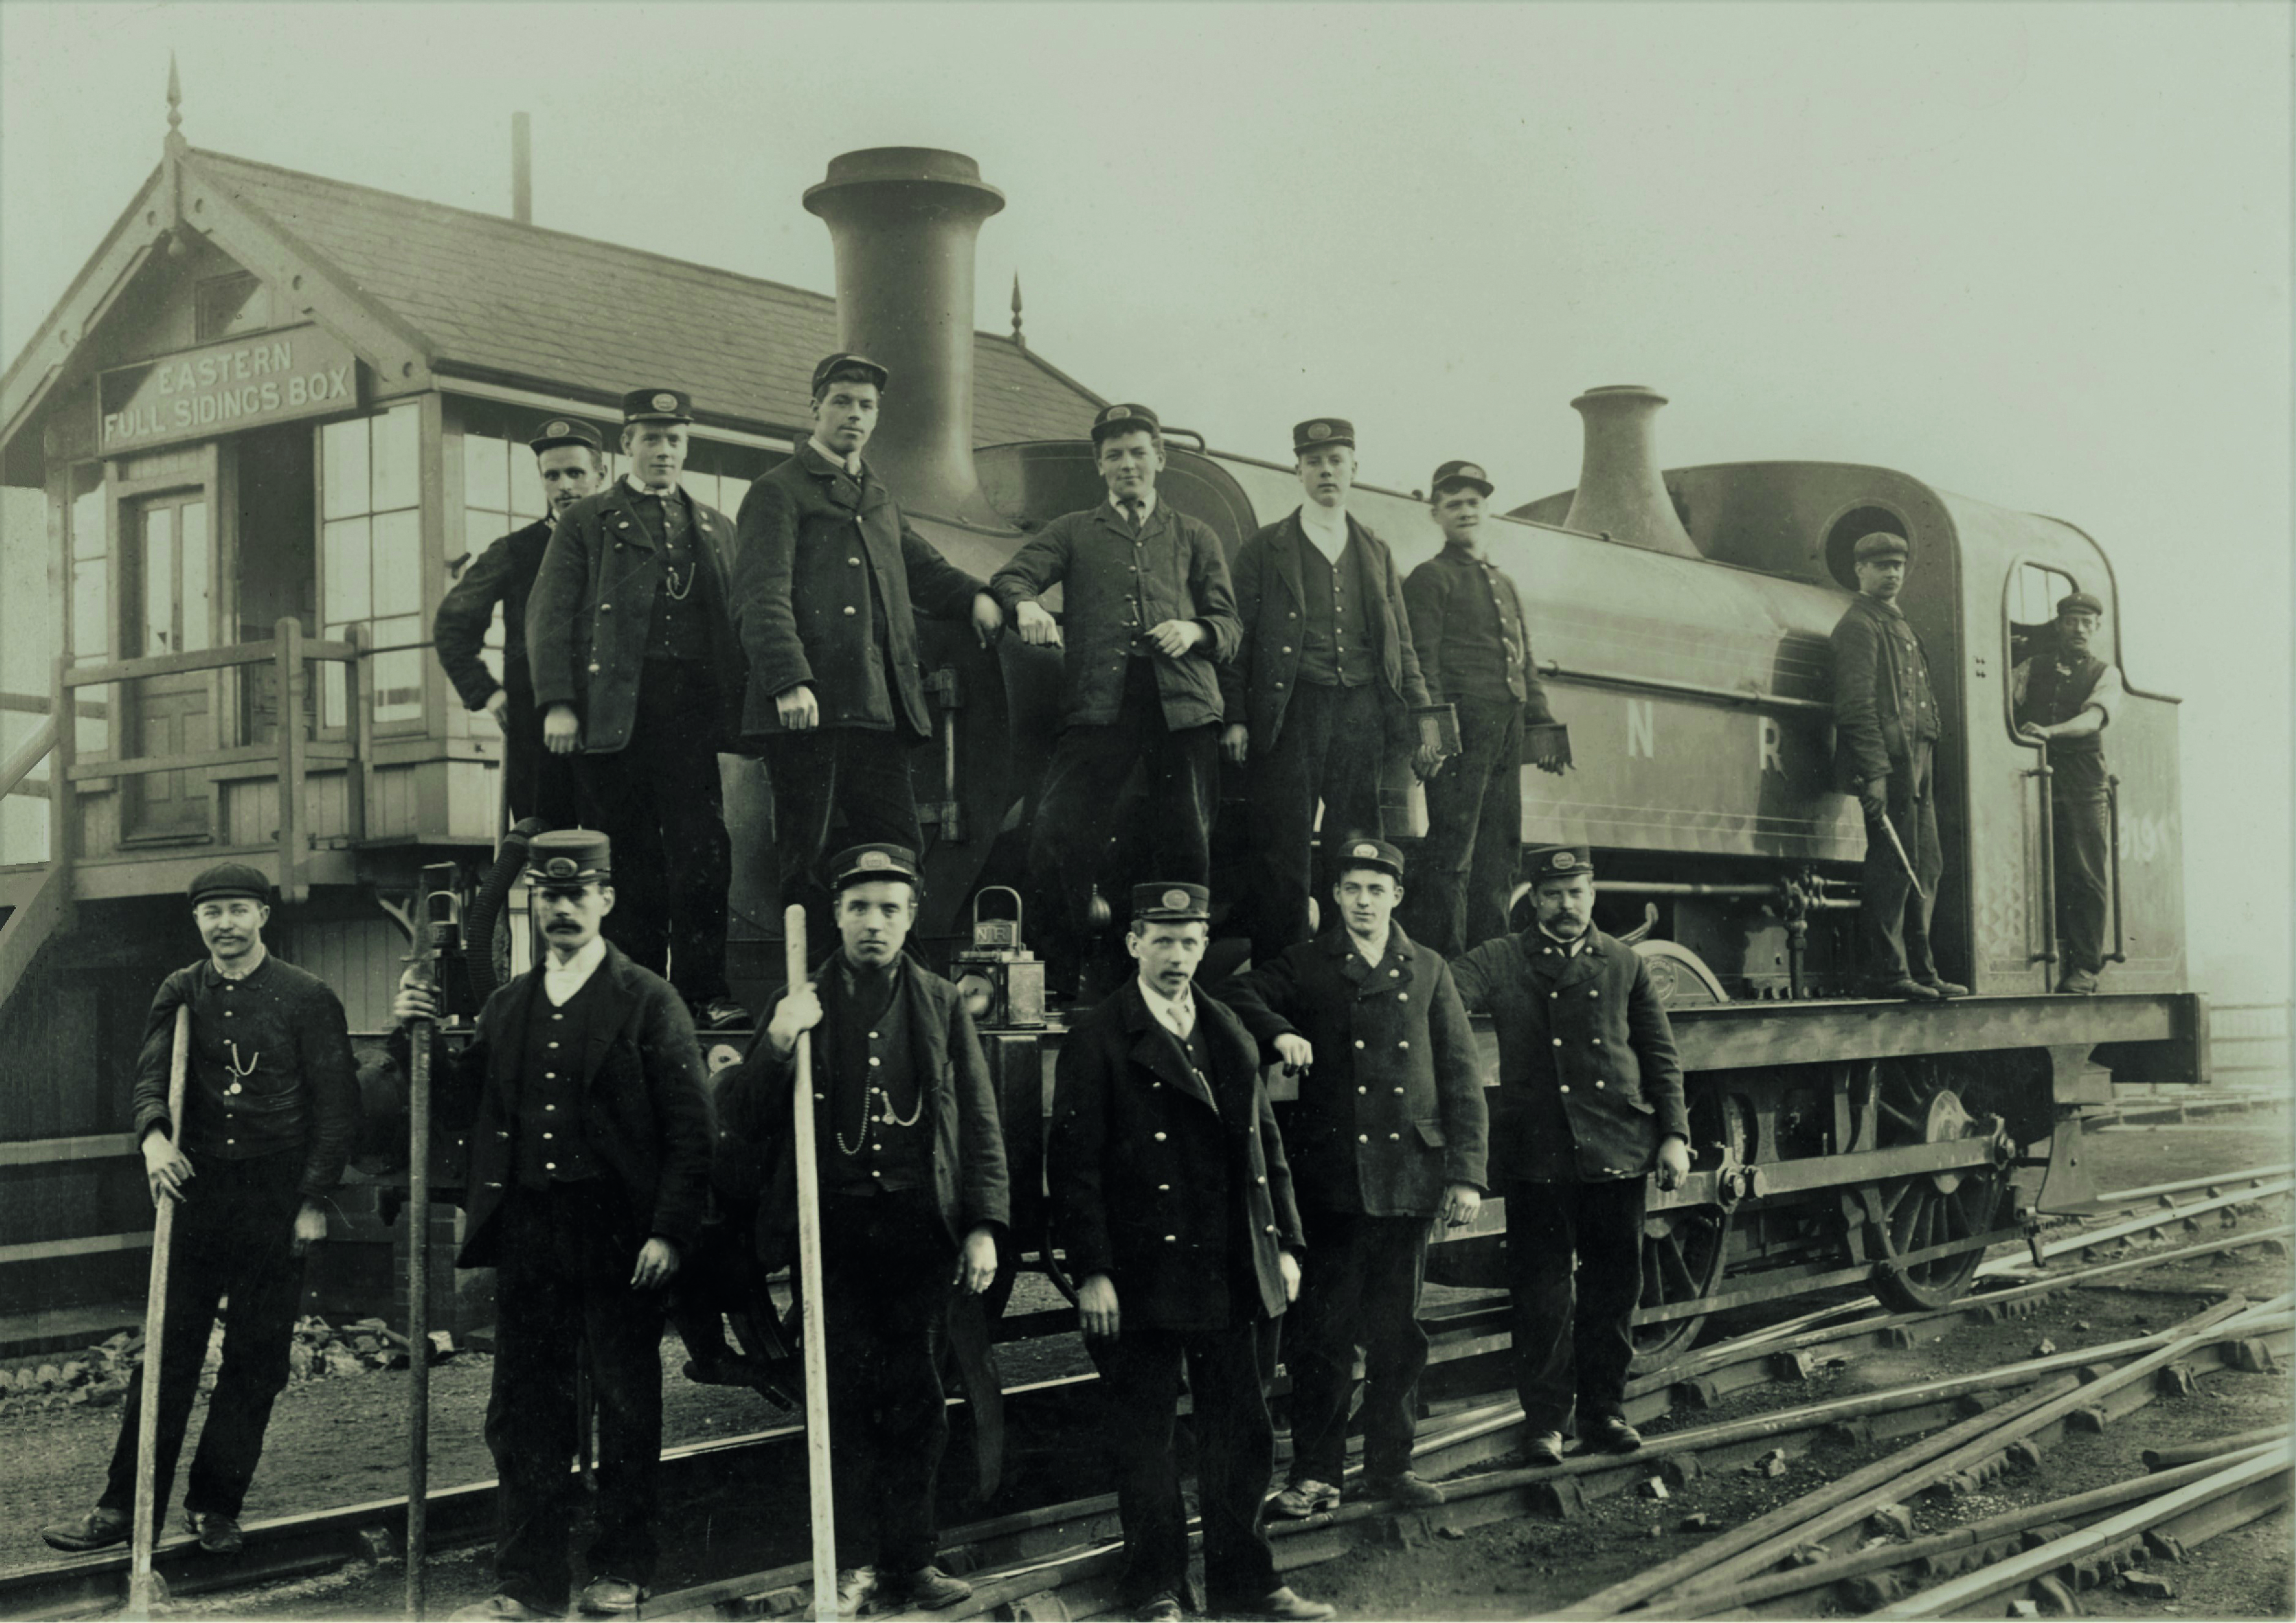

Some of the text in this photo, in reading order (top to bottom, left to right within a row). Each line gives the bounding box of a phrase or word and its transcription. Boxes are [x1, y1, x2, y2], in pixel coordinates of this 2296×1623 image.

[159, 342, 292, 395] EASTERN
[104, 366, 349, 442] FULL SIDINGS BOX
[1628, 699, 1653, 757] N
